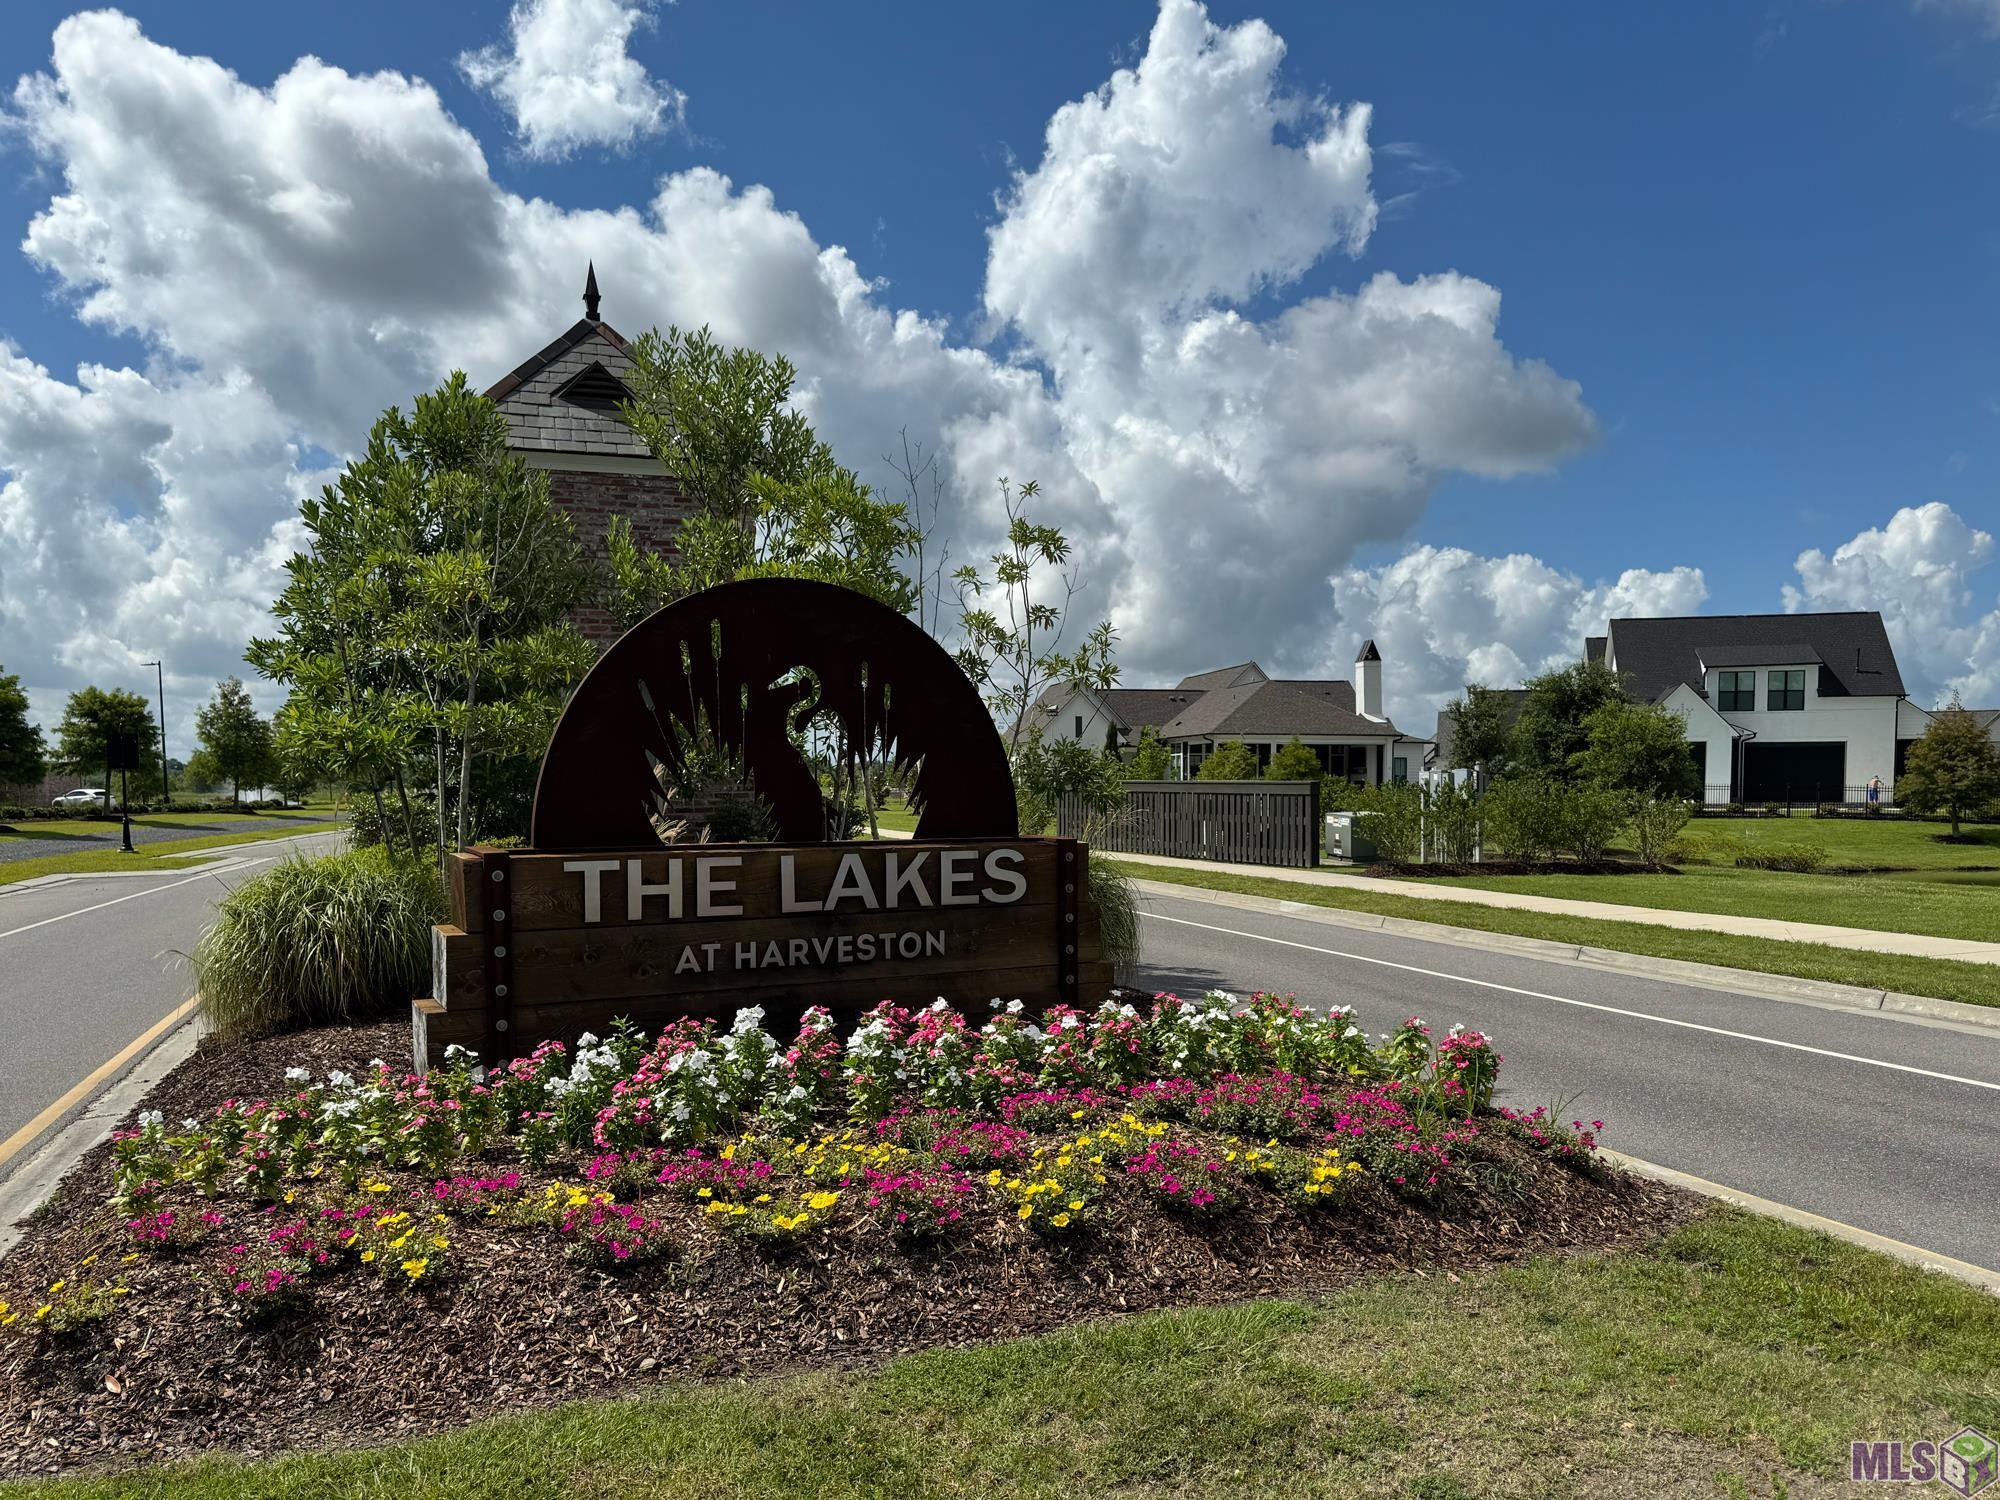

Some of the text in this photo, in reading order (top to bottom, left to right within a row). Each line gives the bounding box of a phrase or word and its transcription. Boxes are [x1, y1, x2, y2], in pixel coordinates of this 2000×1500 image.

[563, 849, 1027, 923] THE LAKES
[674, 930, 946, 975] AT HARVESTON
